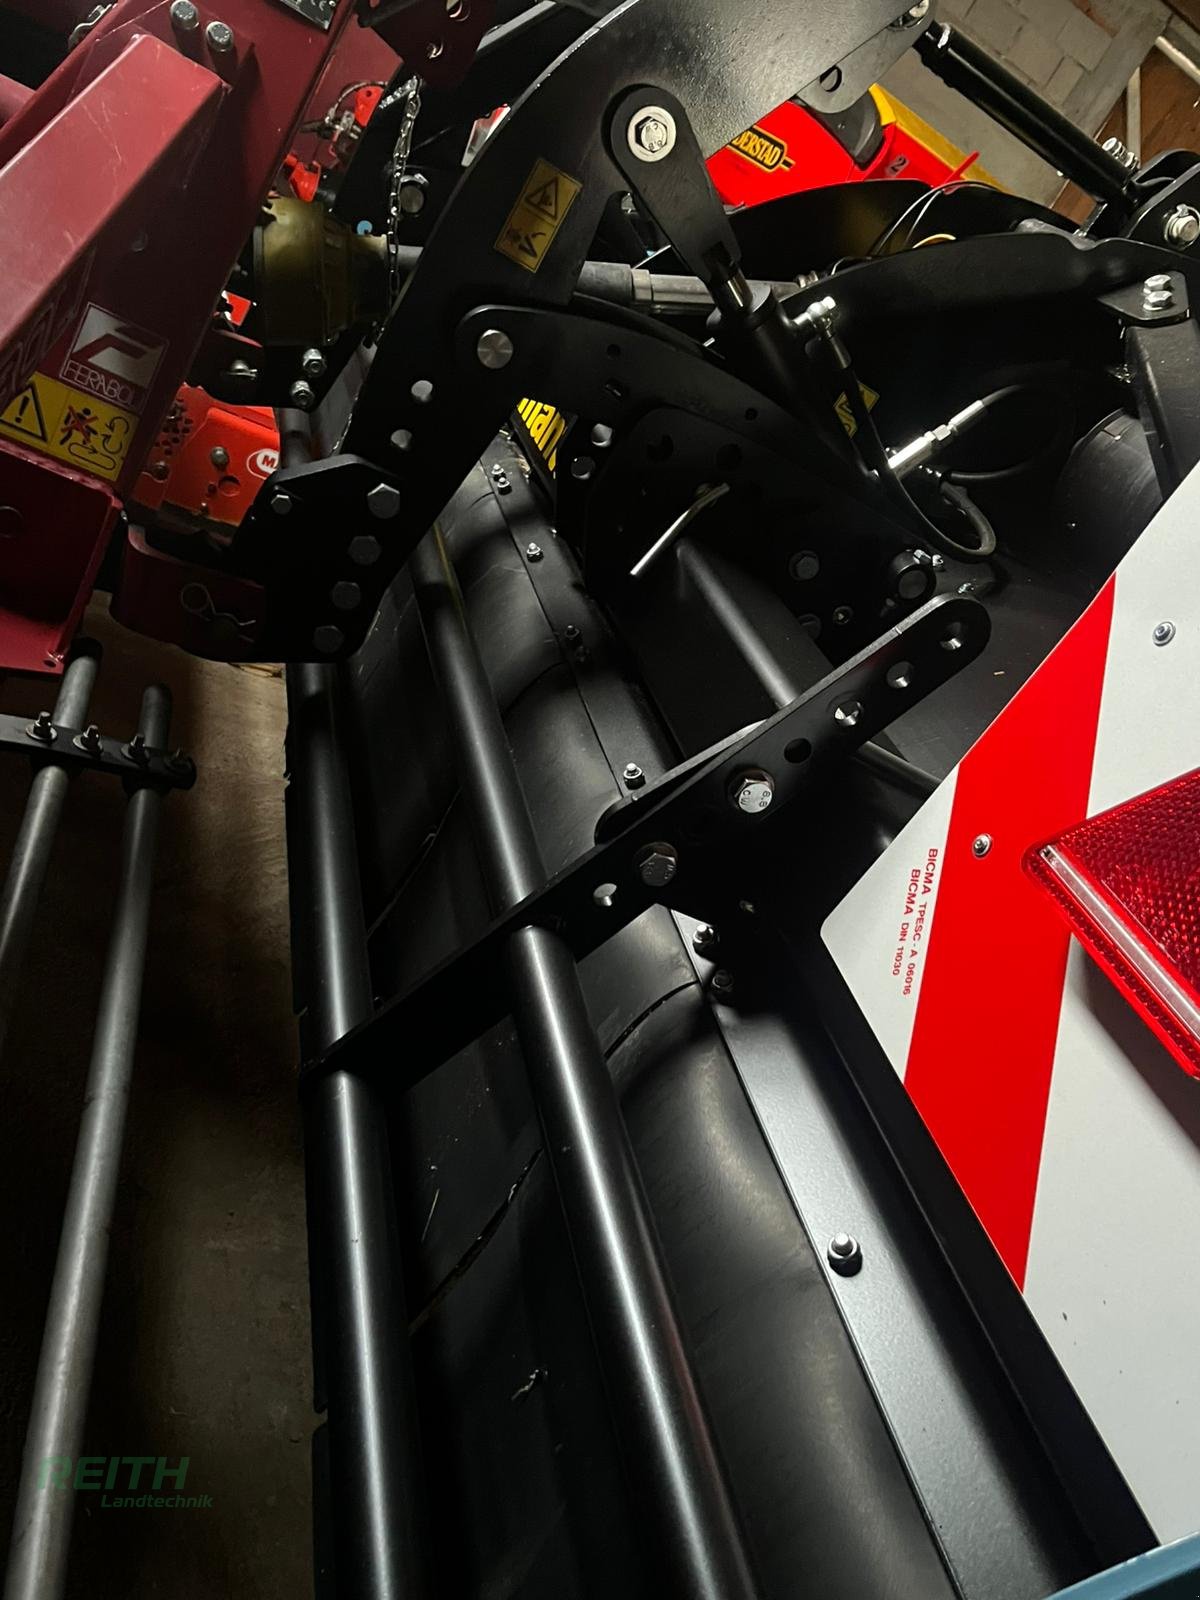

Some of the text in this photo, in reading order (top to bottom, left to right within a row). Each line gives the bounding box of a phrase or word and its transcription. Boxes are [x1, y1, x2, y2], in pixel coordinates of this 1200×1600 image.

[891, 157, 906, 173] 2
[921, 848, 938, 895] BICMA
[892, 869, 921, 976] BICMA DIN 11030
[913, 901, 928, 942] TPESC
[902, 962, 916, 996] 06016
